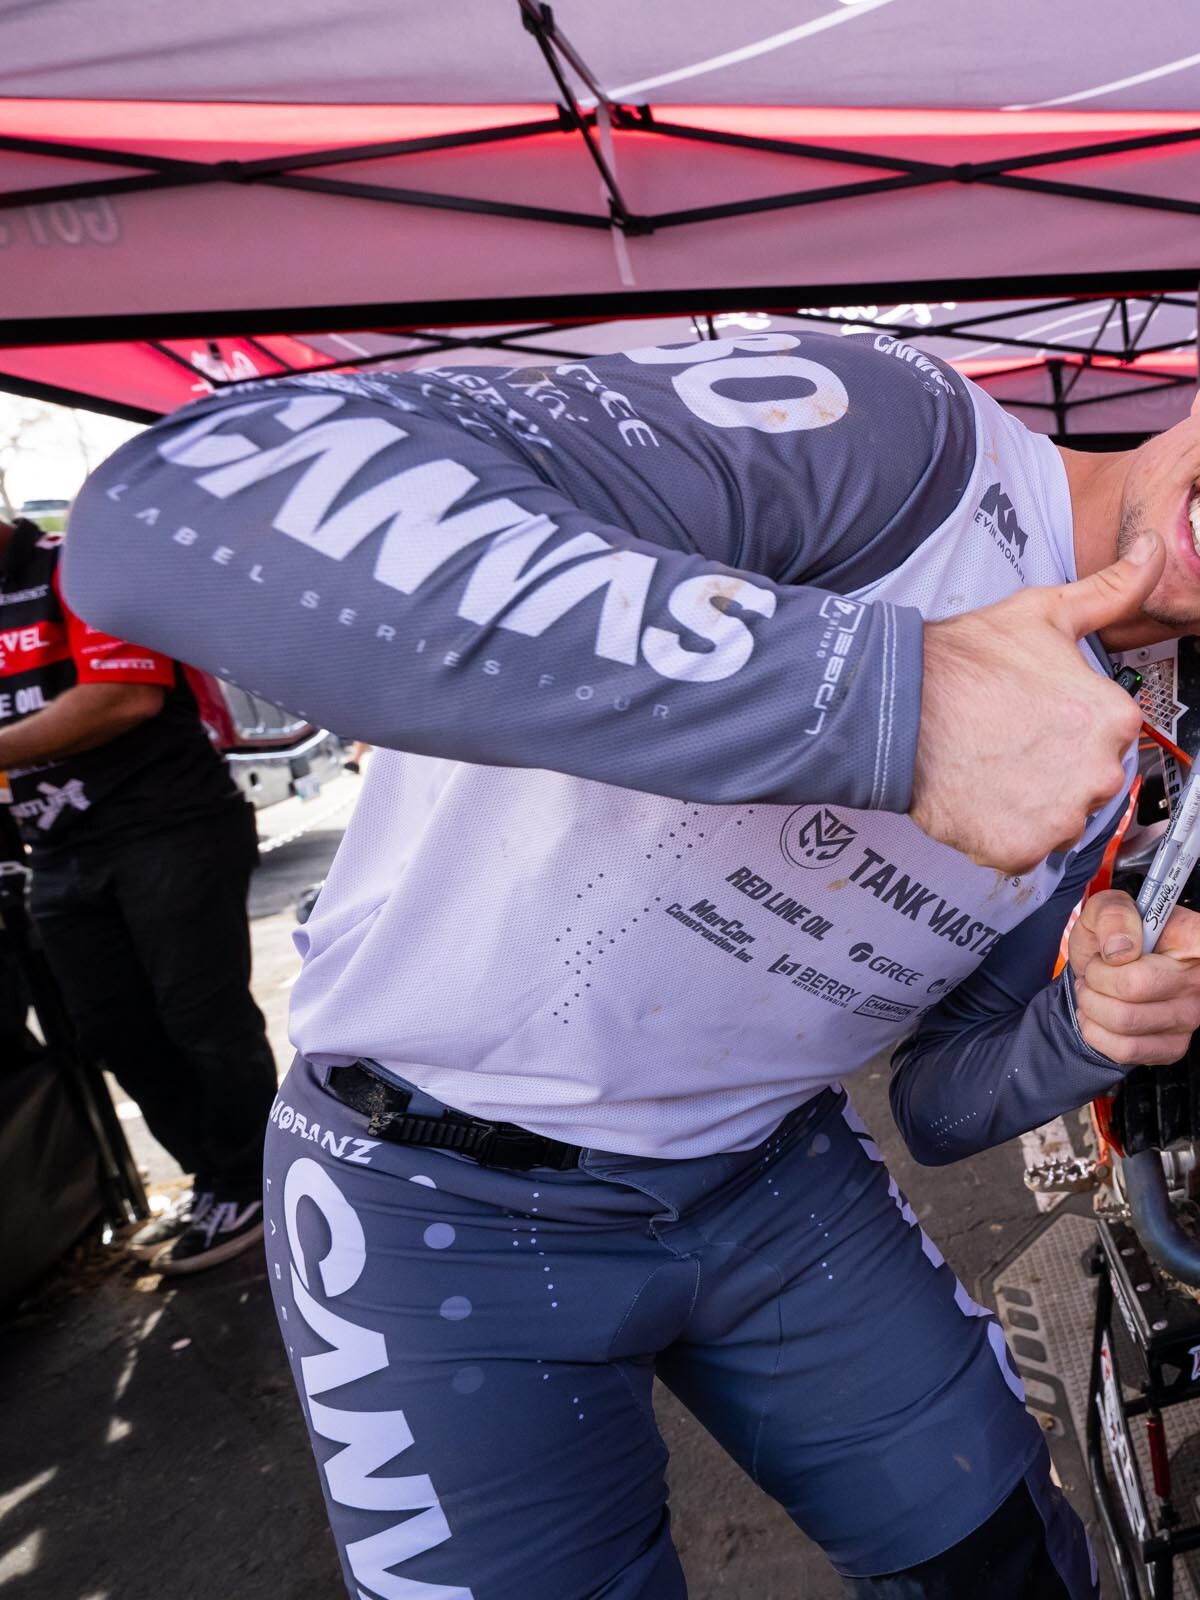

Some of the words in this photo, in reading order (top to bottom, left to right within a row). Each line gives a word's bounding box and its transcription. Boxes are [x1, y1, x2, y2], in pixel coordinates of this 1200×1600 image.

[106, 483, 265, 584] LABEL
[300, 588, 501, 679] SERIES
[539, 673, 671, 722] FOUR
[724, 866, 773, 901] RED
[761, 891, 807, 927] LINE
[802, 914, 835, 942] OIL
[848, 847, 938, 921] TANK
[1145, 881, 1175, 931] Sharpie
[663, 902, 738, 954] Construction
[688, 898, 757, 945] MarCor
[796, 966, 862, 1004] BERRY
[867, 955, 925, 987] GREE
